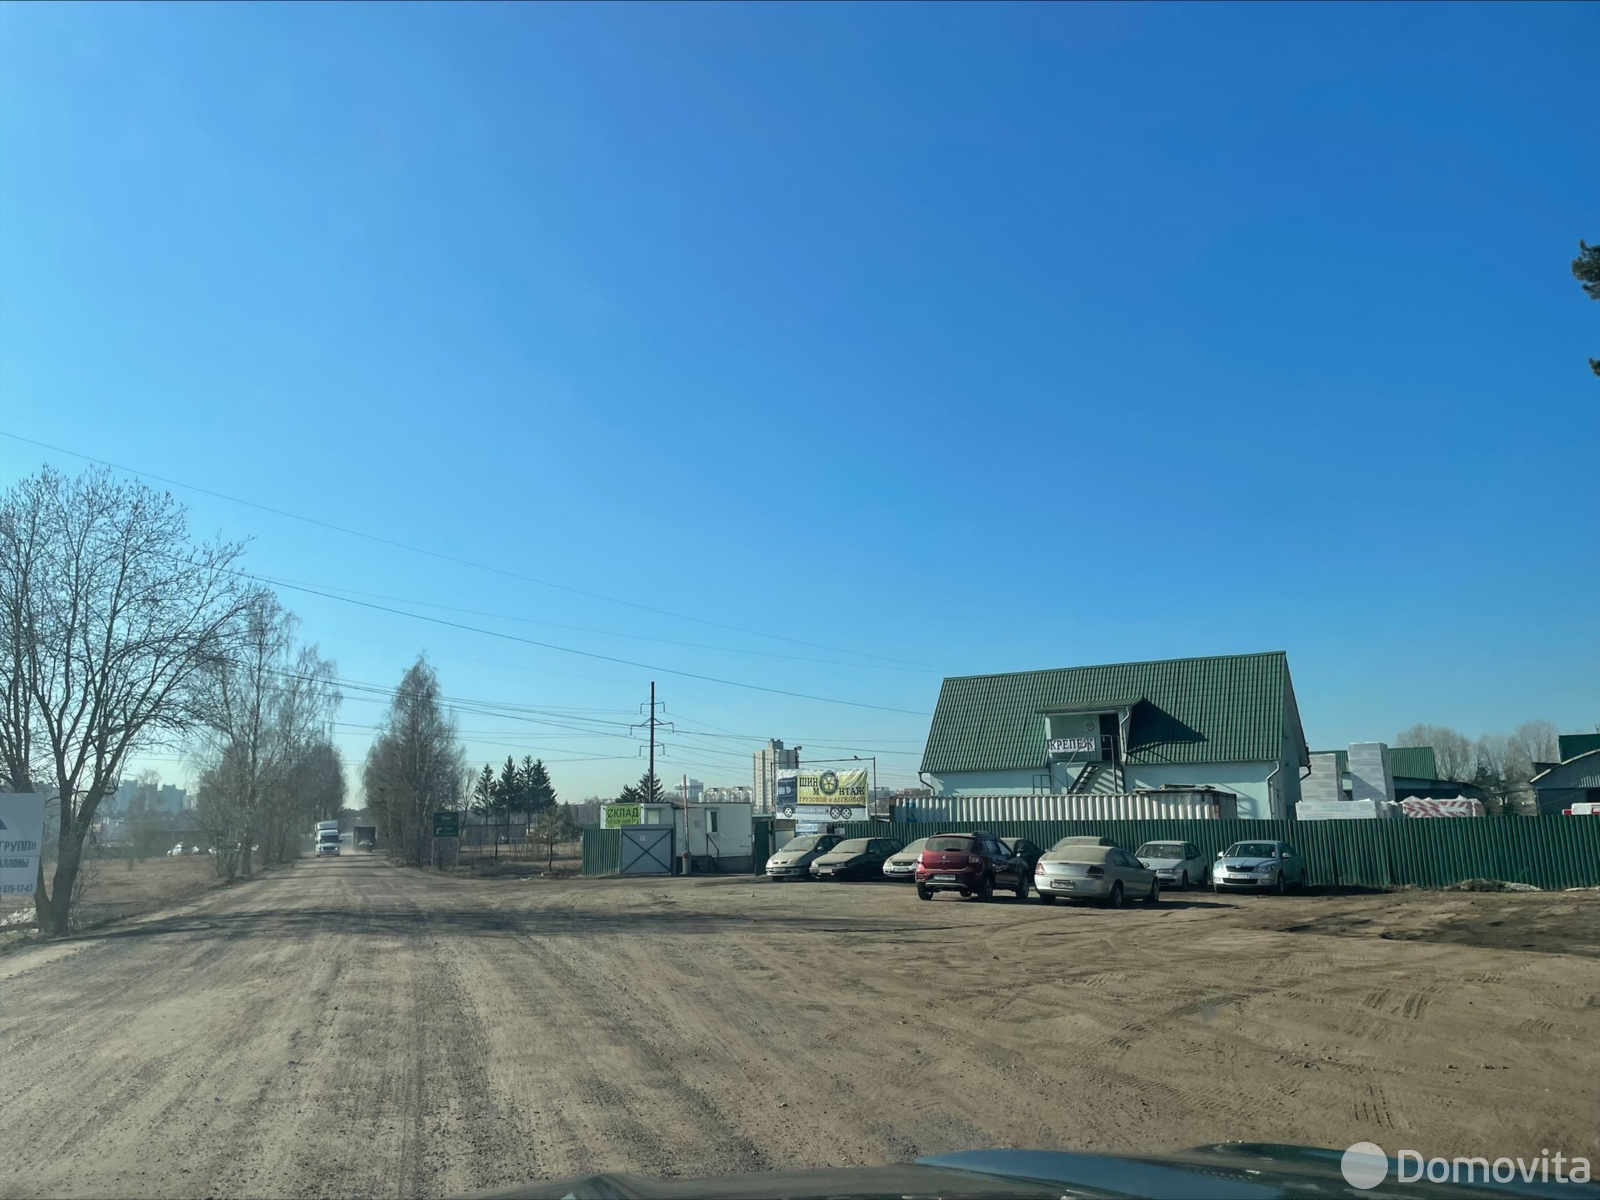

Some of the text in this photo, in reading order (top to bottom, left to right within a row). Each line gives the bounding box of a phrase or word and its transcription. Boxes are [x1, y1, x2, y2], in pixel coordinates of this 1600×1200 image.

[1049, 737, 1094, 750] КРЕПЕЖ
[799, 777, 819, 787] ШИН
[607, 808, 639, 818] СКЛАД
